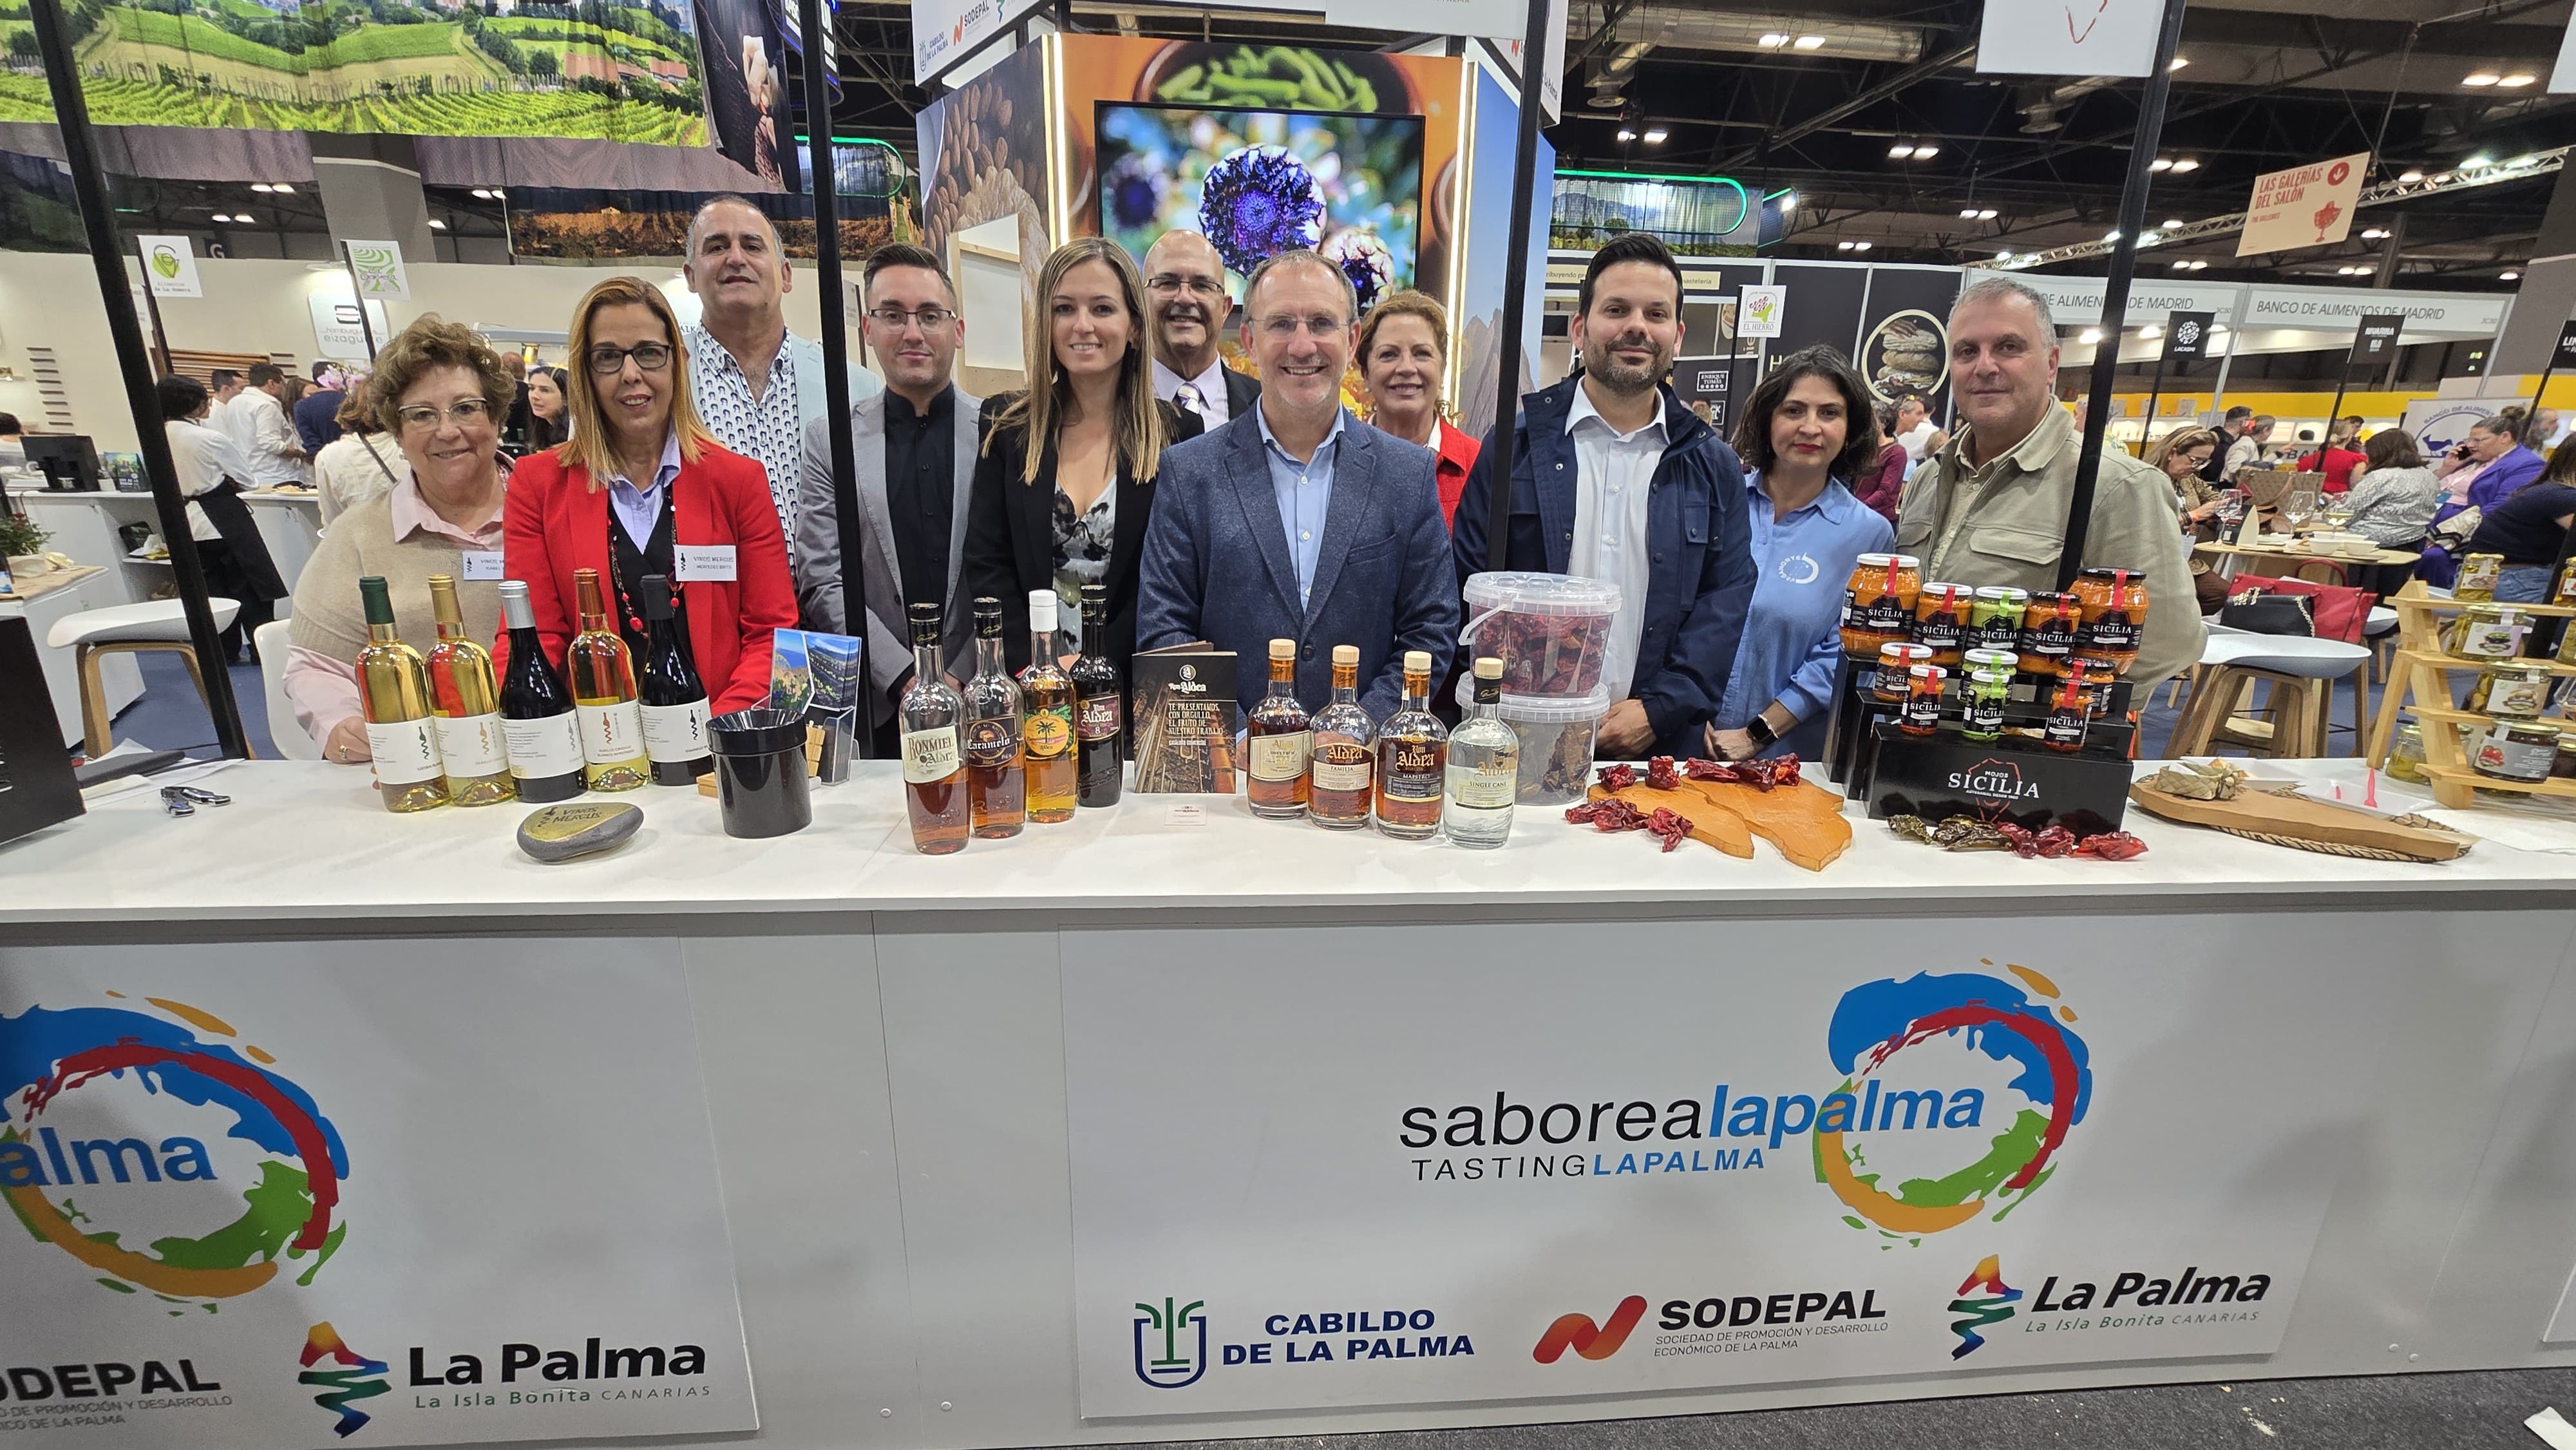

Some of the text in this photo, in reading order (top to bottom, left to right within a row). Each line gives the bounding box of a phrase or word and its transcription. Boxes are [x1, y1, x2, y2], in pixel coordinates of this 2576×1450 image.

[964, 1, 990, 27] SODEPAL
[929, 32, 945, 48] CABILDO
[2259, 167, 2324, 193] LAS GALERÍAS
[2255, 185, 2306, 210] DEL SALÓN
[1546, 271, 1577, 279] ribuyendo
[2057, 294, 2103, 308] ALIMEN
[2128, 297, 2143, 308] DE
[2146, 297, 2194, 310] MADRID
[2257, 301, 2445, 320] BANCO DE ALIMENTOS DE MADRID
[1752, 323, 1774, 331] HIERRO
[324, 334, 383, 345] eizague
[2424, 408, 2450, 424] BANCO
[2464, 405, 2496, 419] ALIMENT
[1868, 608, 1903, 619] SICILIA
[1922, 625, 1960, 636] SICILIA
[1980, 630, 2018, 640] SICILIA
[2035, 633, 2074, 643] SICILIA
[2093, 625, 2132, 634] SICILIA
[1180, 681, 1207, 694] Aldea
[1886, 675, 1909, 684] SICIL
[1177, 703, 1220, 711] PRESENTAMOS,
[1081, 710, 1113, 727] Aldea
[2049, 717, 2083, 727] SICILIA
[967, 736, 1010, 750] Caramelo
[1411, 744, 1426, 753] Ron
[1325, 745, 1363, 764] Aldea
[1395, 751, 1435, 771] Aldea
[1948, 772, 2040, 799] SICILIA
[563, 806, 598, 815] VINOS
[2031, 1266, 2271, 1313] La Palma
[1658, 1289, 1887, 1331] SODEPAL
[1264, 1309, 1435, 1336] CABILDO
[2025, 1311, 2260, 1333] La Isla Bonita CANARIAS
[1655, 1322, 1888, 1345] SOCIEDAD DE PROMOCIÓN Y DESARROLLO
[1223, 1335, 1475, 1366] DE LA PALMA
[1654, 1339, 1798, 1357] ECONÓMICO DE LA PALMA
[410, 1337, 706, 1387] La Palma
[0, 1359, 222, 1403] DEPAL
[415, 1385, 710, 1409] La Isla Bonita CANARIAS
[10, 1406, 33, 1417] DE
[35, 1400, 122, 1415] PROMOCIÓN
[123, 1401, 134, 1409] Y
[137, 1395, 233, 1410] DESARROLLO
[29, 1418, 50, 1429] DE
[53, 1417, 73, 1428] LA
[74, 1415, 126, 1426] PALMA
